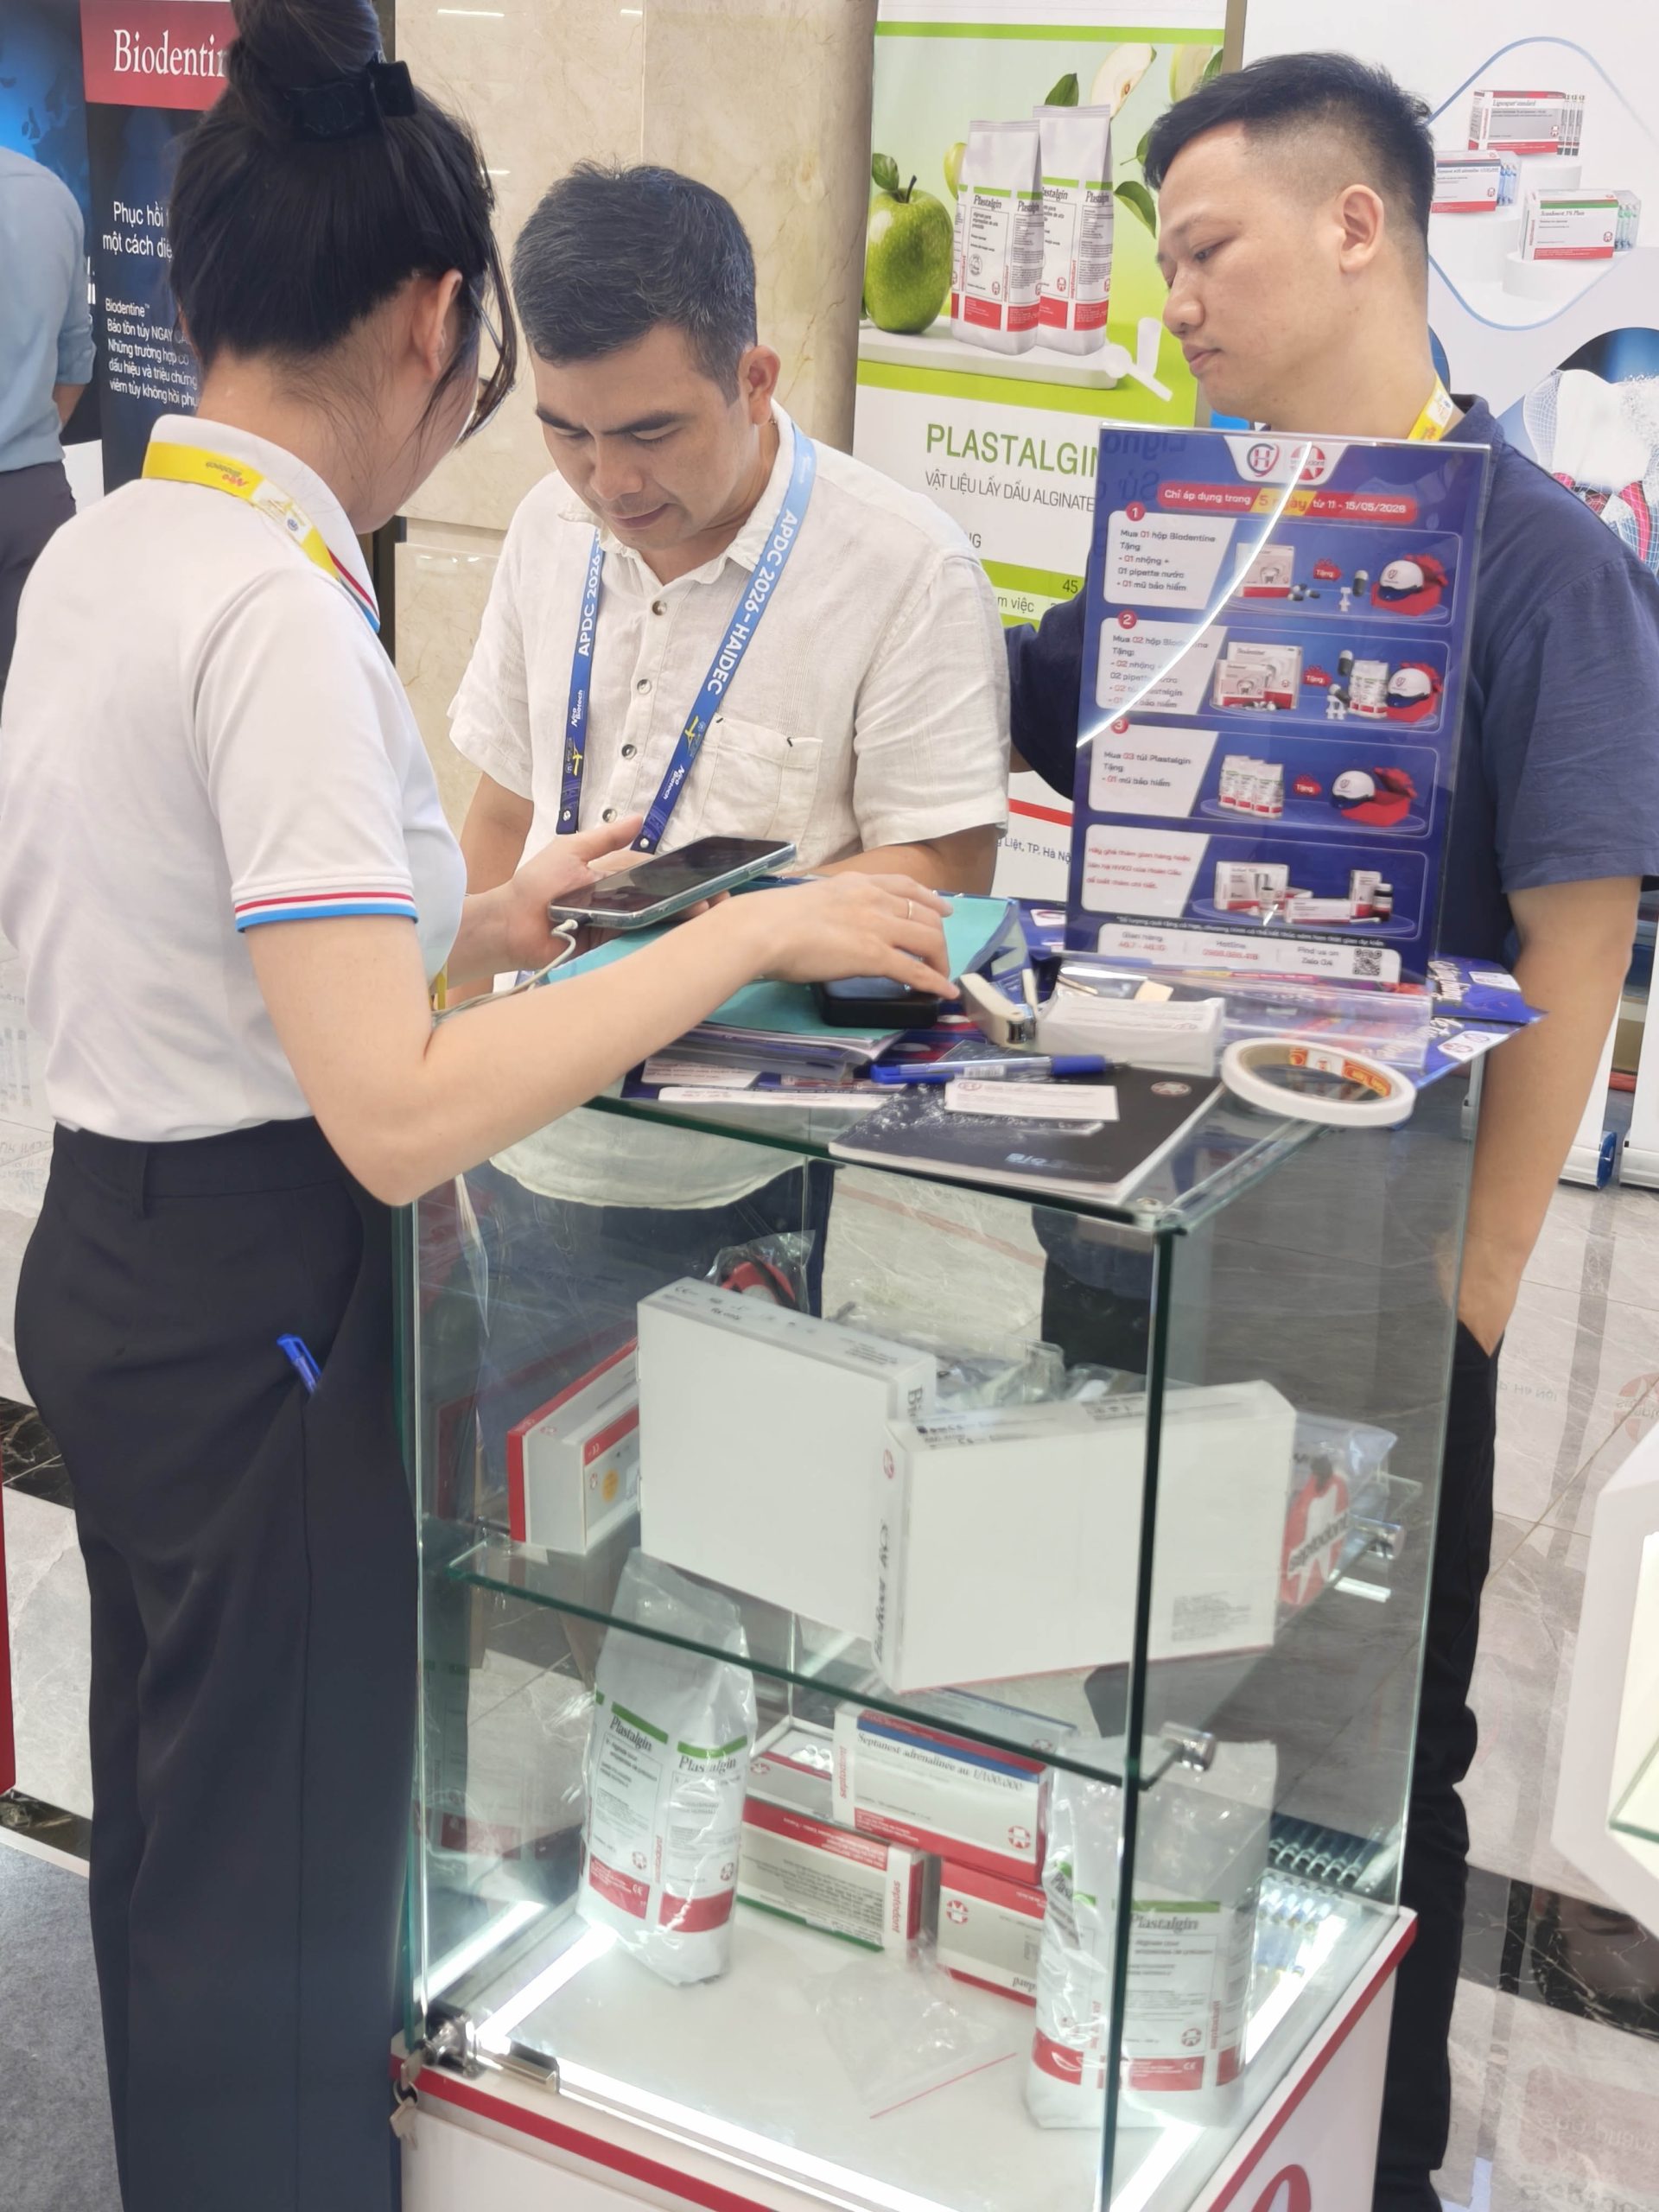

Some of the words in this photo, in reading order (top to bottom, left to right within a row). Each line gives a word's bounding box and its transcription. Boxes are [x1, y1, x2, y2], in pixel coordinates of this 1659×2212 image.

[113, 200, 143, 228] Phục
[146, 201, 164, 227] hồi
[103, 231, 123, 256] một
[124, 233, 154, 257] cách
[156, 237, 173, 262] diệ
[107, 318, 122, 334] Bảo
[123, 321, 136, 336] tồn
[151, 326, 173, 341] NGAY
[108, 339, 133, 359] Những
[135, 343, 162, 363] trường
[162, 348, 177, 365] hợp
[109, 358, 123, 373] dấu
[124, 363, 141, 378] hiệu
[142, 366, 153, 378] và
[153, 367, 170, 383] triệu
[110, 378, 128, 391] viêm
[143, 384, 168, 404] không
[925, 468, 947, 490] VẬT
[950, 472, 976, 495] LIỆU
[978, 474, 1001, 497] LẤY
[1004, 479, 1030, 502] DẤU
[1033, 489, 1095, 512] ALGINATE
[1164, 489, 1181, 499] Chỉ
[1183, 491, 1195, 501] áp
[1198, 492, 1223, 503] dụng
[1259, 494, 1268, 505] 5
[1132, 507, 1139, 518] 1
[767, 509, 798, 565] APDC
[1152, 531, 1167, 541] hộp
[1063, 579, 1078, 594] 45
[1012, 596, 1034, 613] việc
[578, 605, 594, 657] APDC
[1123, 614, 1131, 625] 2
[708, 624, 751, 696] HAIDEC
[1005, 837, 1025, 852] Liệt,
[1027, 842, 1040, 855] TP.
[1043, 846, 1055, 859] Hà
[1058, 851, 1071, 864] Nộ
[610, 1715, 653, 1751] Plastalgin
[858, 1733, 900, 1755] Septanest
[679, 1755, 737, 1774] Plasalgin
[839, 1745, 848, 1799] septodont
[892, 1879, 900, 1934] septodont
